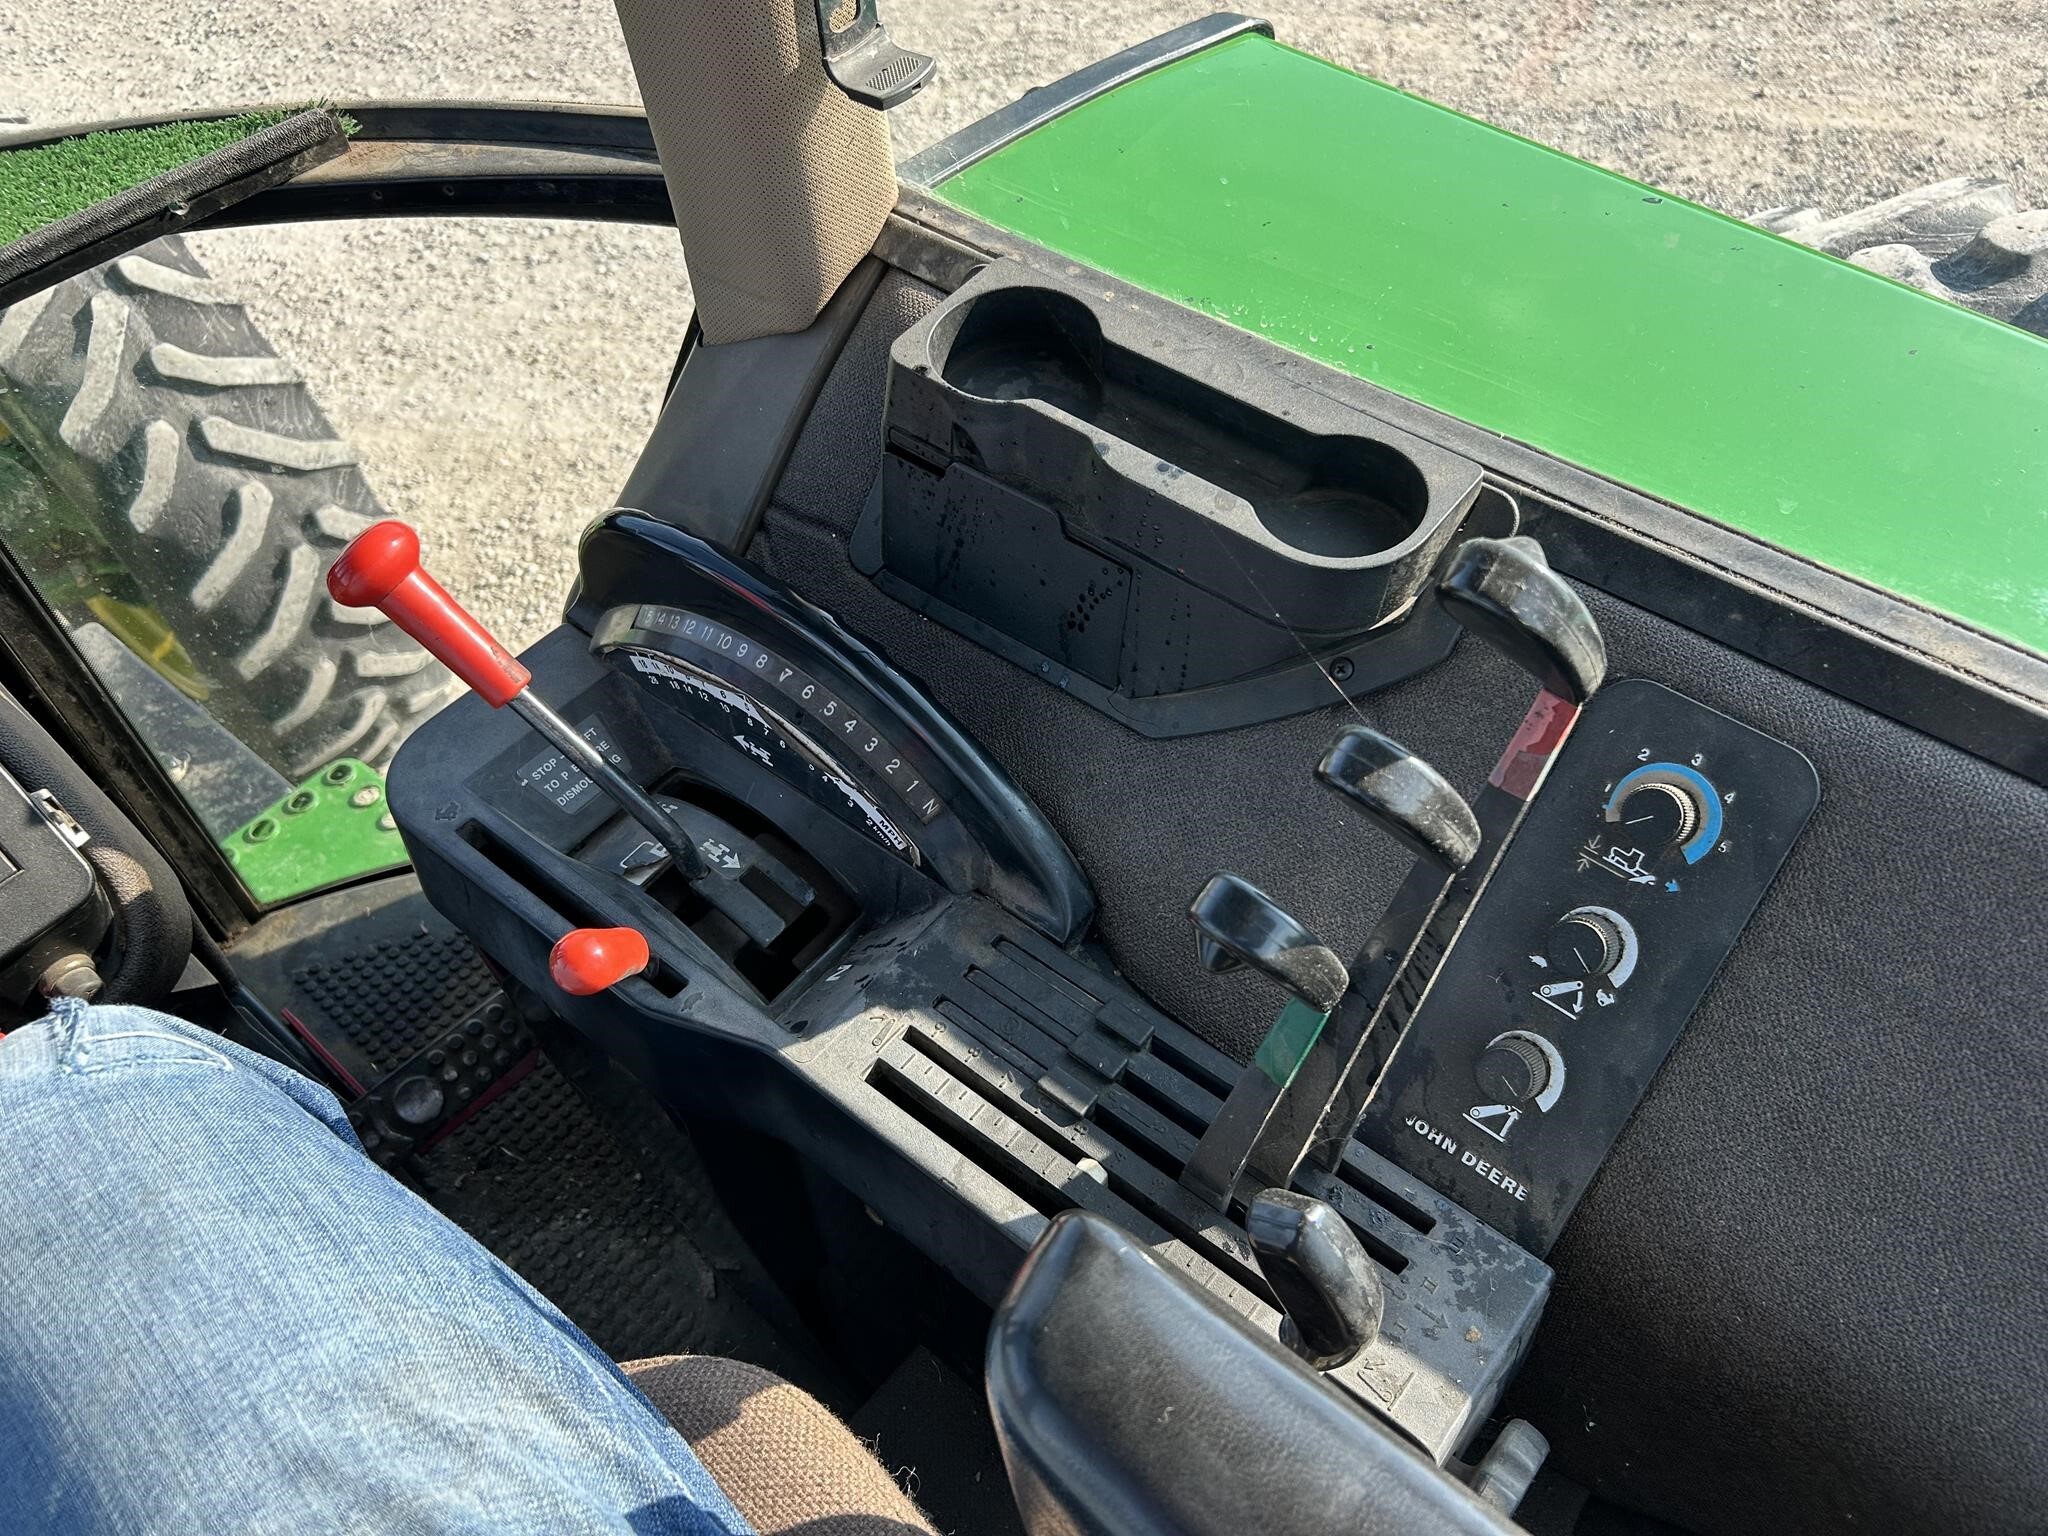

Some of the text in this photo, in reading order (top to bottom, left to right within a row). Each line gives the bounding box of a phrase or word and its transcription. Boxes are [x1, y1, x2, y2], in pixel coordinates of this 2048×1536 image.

[655, 612, 666, 624] 14
[668, 615, 681, 629] 13
[683, 619, 697, 634] 12
[700, 625, 714, 641] 11
[717, 633, 732, 649] 10
[736, 643, 749, 658] 9
[755, 654, 768, 669] 8
[779, 668, 793, 683] 7
[801, 684, 815, 699] 6
[823, 701, 838, 716] 5
[844, 719, 857, 733] 4
[864, 737, 879, 752] 3
[885, 758, 900, 774] 2
[906, 780, 919, 793] 1
[922, 798, 939, 815] N
[698, 690, 710, 702] 12
[531, 757, 558, 781] STOP
[543, 779, 560, 793] TO
[563, 773, 569, 781] P
[1604, 747, 1736, 853] 1 2 3 4 5
[1404, 1114, 1530, 1201] JOHN DEERE
